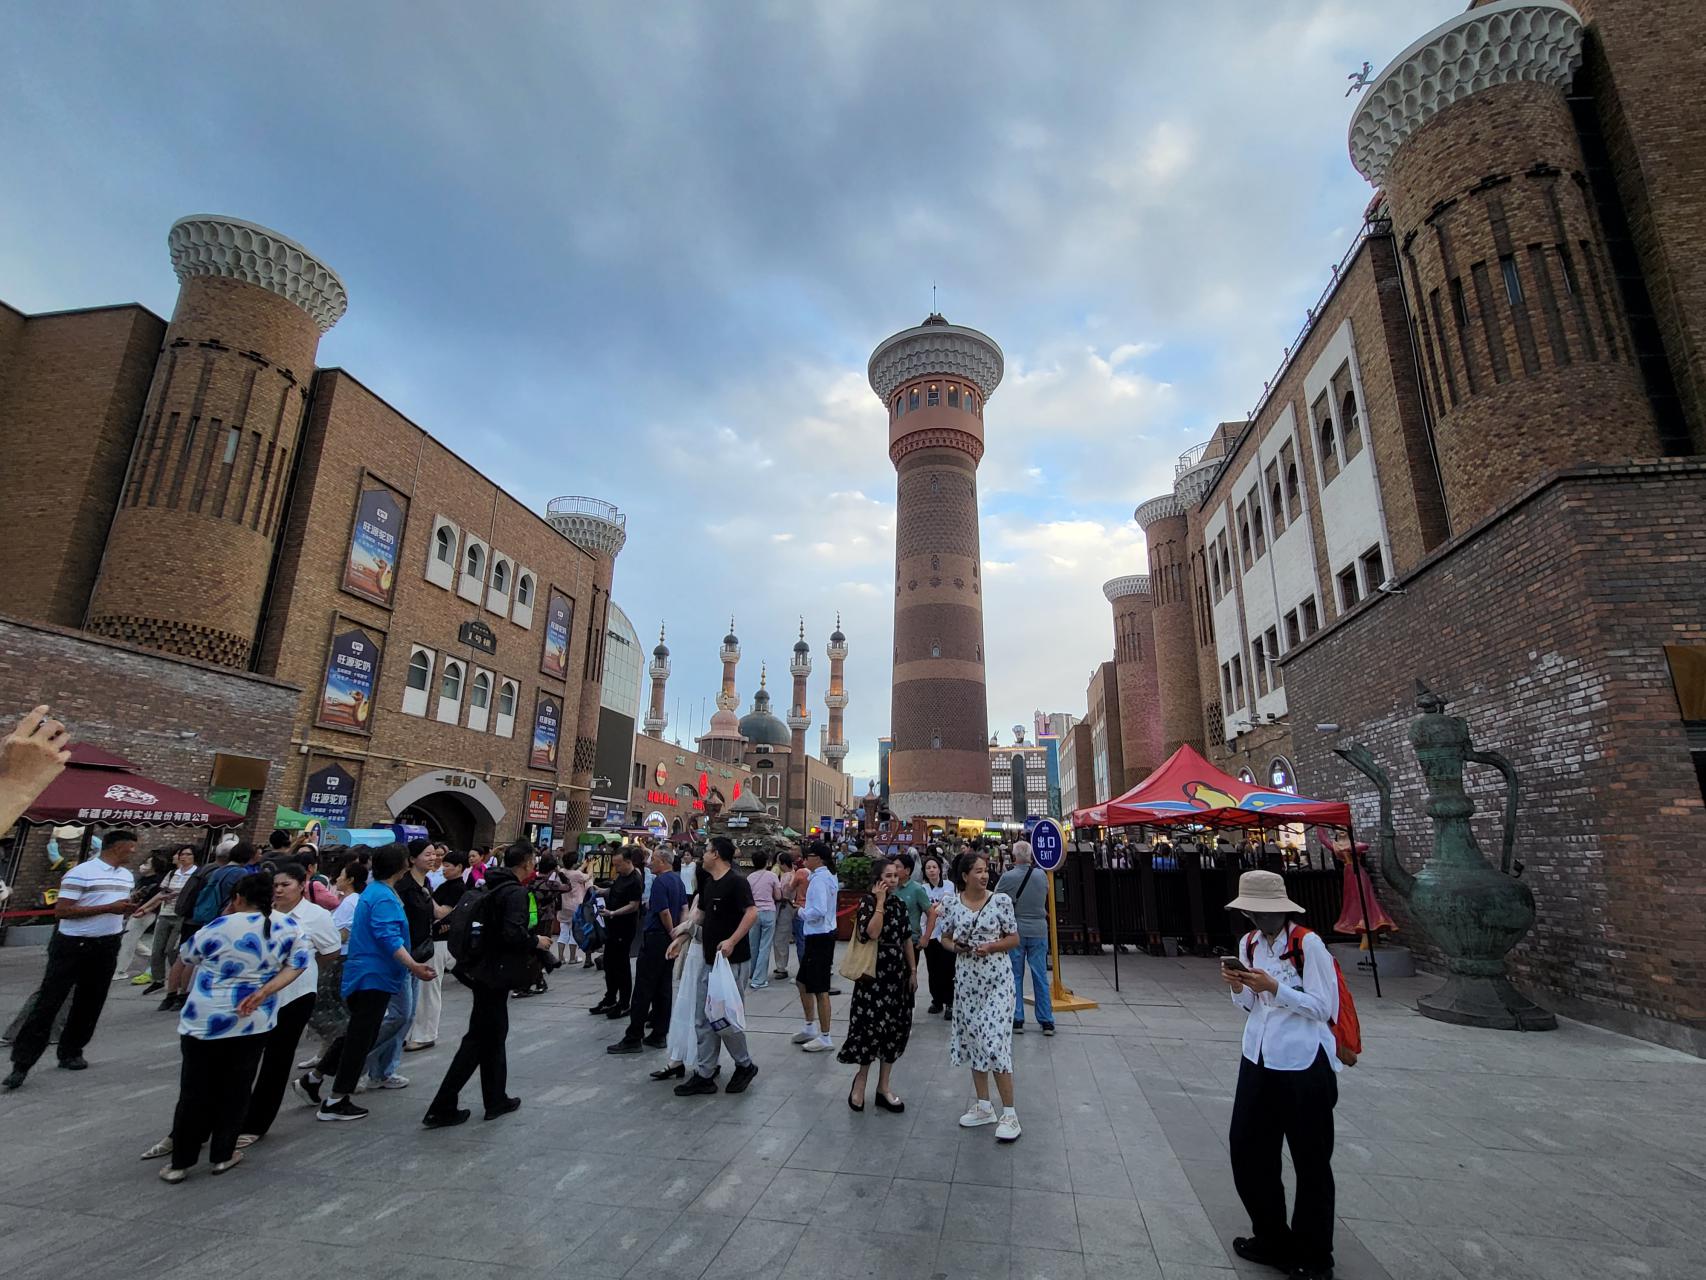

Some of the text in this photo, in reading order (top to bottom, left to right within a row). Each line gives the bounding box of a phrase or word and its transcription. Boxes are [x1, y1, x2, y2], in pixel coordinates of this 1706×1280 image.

[337, 653, 371, 672] 旺源驼奶
[311, 792, 348, 805] 旺源驼奶
[78, 808, 209, 822] 新疆伊力特实业股份有限公司
[1037, 836, 1055, 848] 出口
[1040, 850, 1053, 860] EXIT
